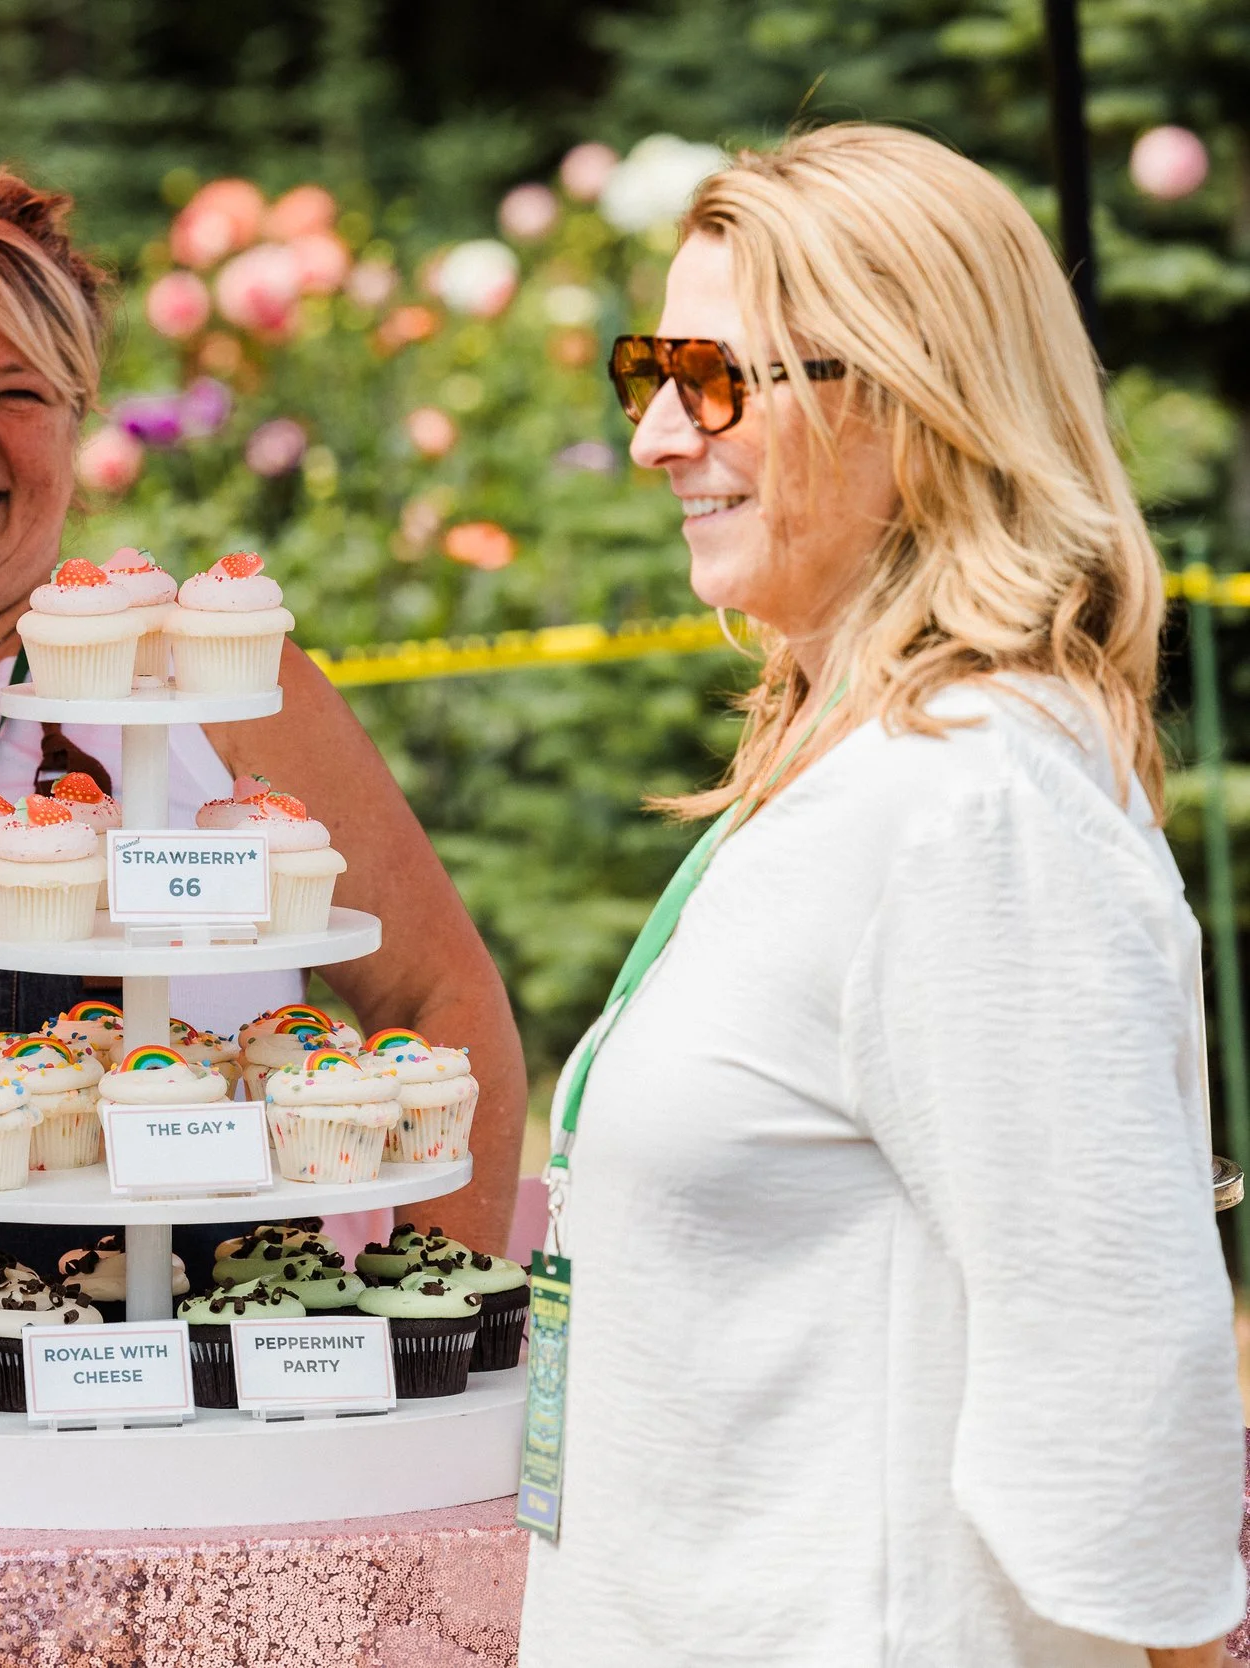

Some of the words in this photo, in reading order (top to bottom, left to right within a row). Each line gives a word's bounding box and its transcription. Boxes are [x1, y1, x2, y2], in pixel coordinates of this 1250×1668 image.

[122, 850, 247, 865] STRAWBERRY
[169, 877, 202, 897] 66
[146, 1122, 182, 1136] THE
[187, 1121, 223, 1135] GAY
[254, 1336, 366, 1350] PEPPERMINT
[44, 1346, 115, 1362] ROYALE
[120, 1344, 168, 1359] WITH
[283, 1359, 340, 1373] PARTY
[73, 1369, 143, 1384] CHEESE
